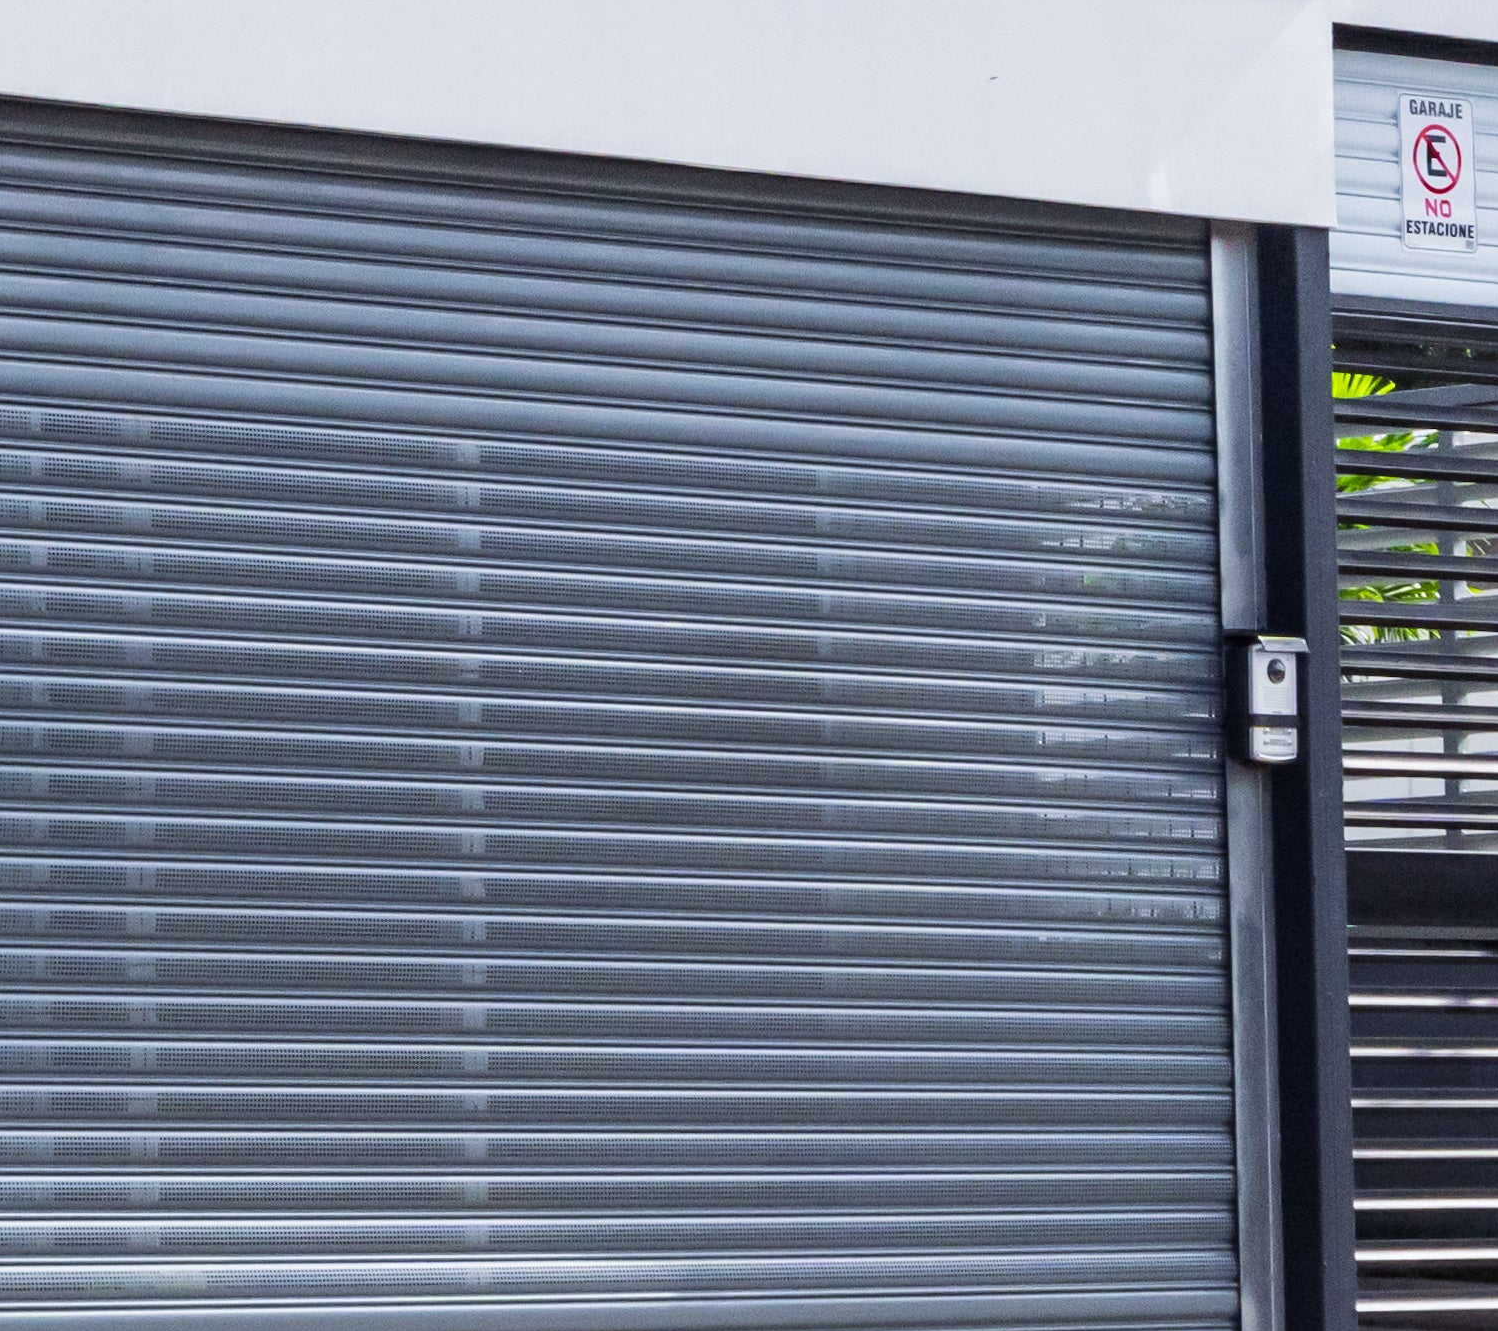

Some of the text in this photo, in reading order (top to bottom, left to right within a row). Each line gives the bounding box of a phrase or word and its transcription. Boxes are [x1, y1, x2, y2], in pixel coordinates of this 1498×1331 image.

[1409, 99, 1463, 119] GARAJE
[1424, 198, 1452, 218] NO
[1406, 219, 1475, 239] ESTACIONE
